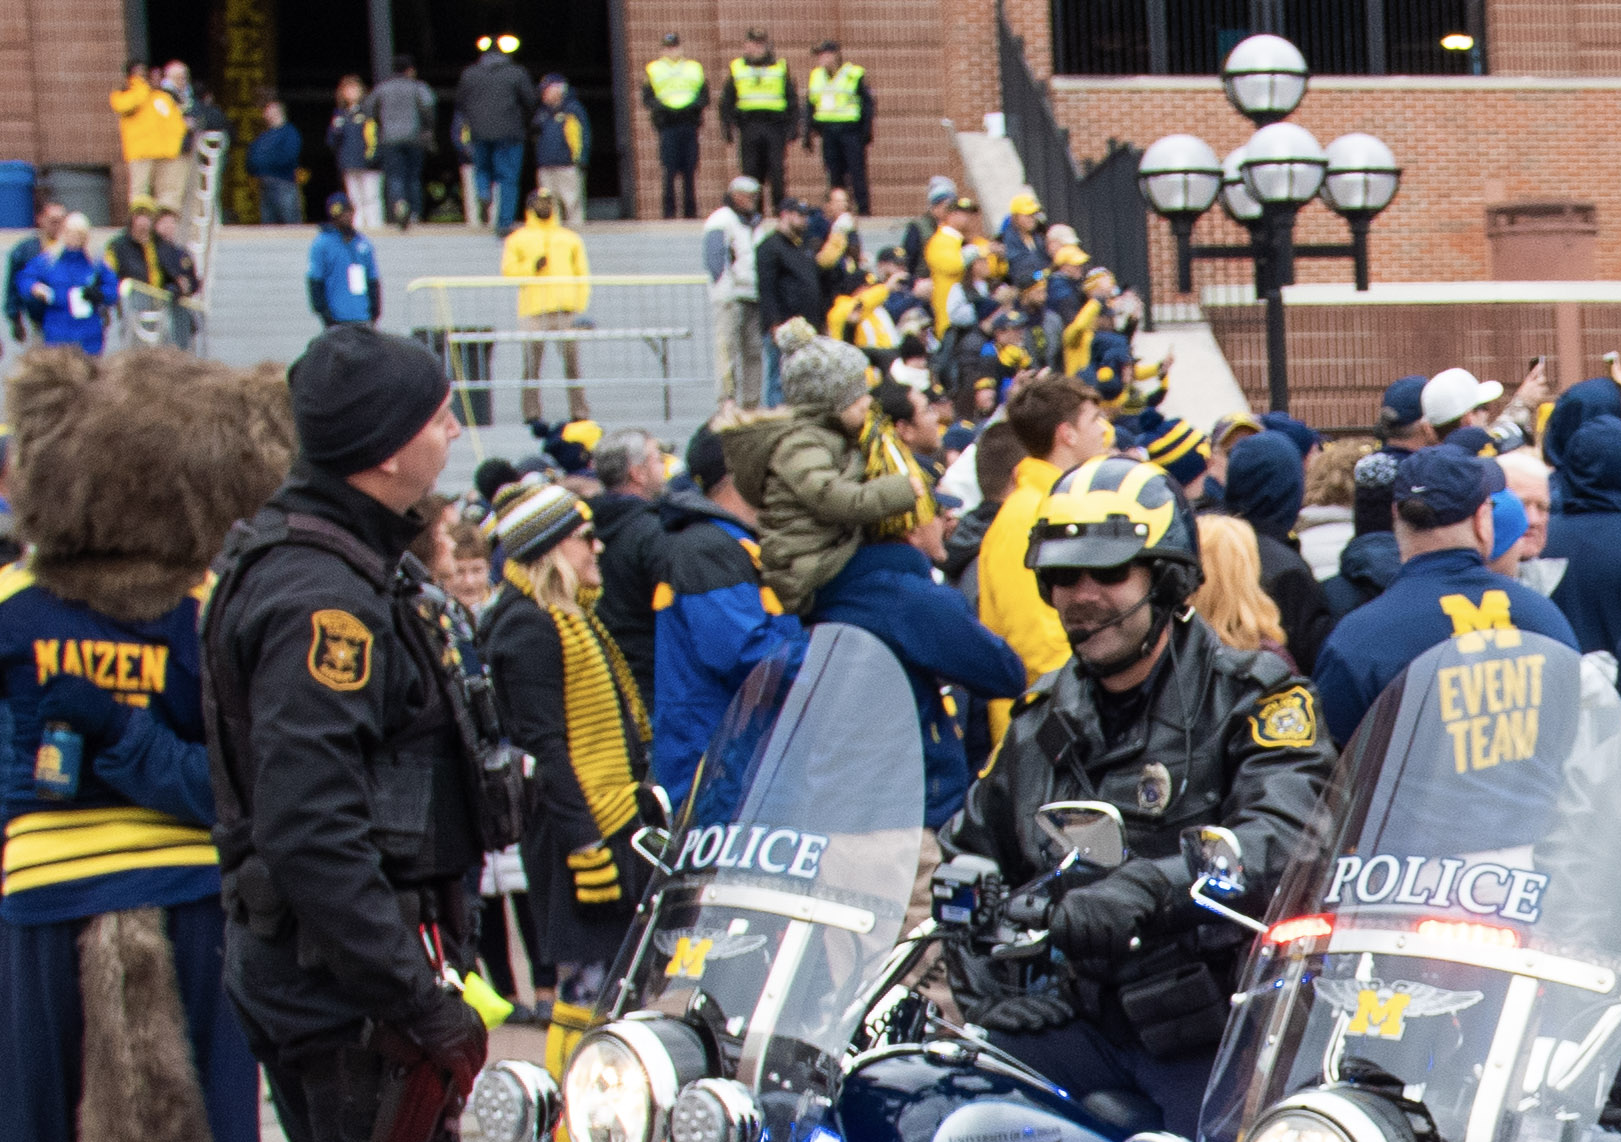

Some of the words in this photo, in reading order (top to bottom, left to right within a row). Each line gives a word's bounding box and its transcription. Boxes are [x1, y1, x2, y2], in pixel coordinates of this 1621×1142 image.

[1439, 590, 1522, 653] M
[33, 639, 169, 693] MAIZEN
[1437, 654, 1547, 723] EVENT
[1446, 707, 1540, 775] TEAM
[673, 823, 829, 879] POLICE
[1323, 853, 1549, 923] POLICE
[664, 936, 714, 980] M
[1346, 989, 1412, 1042] M
